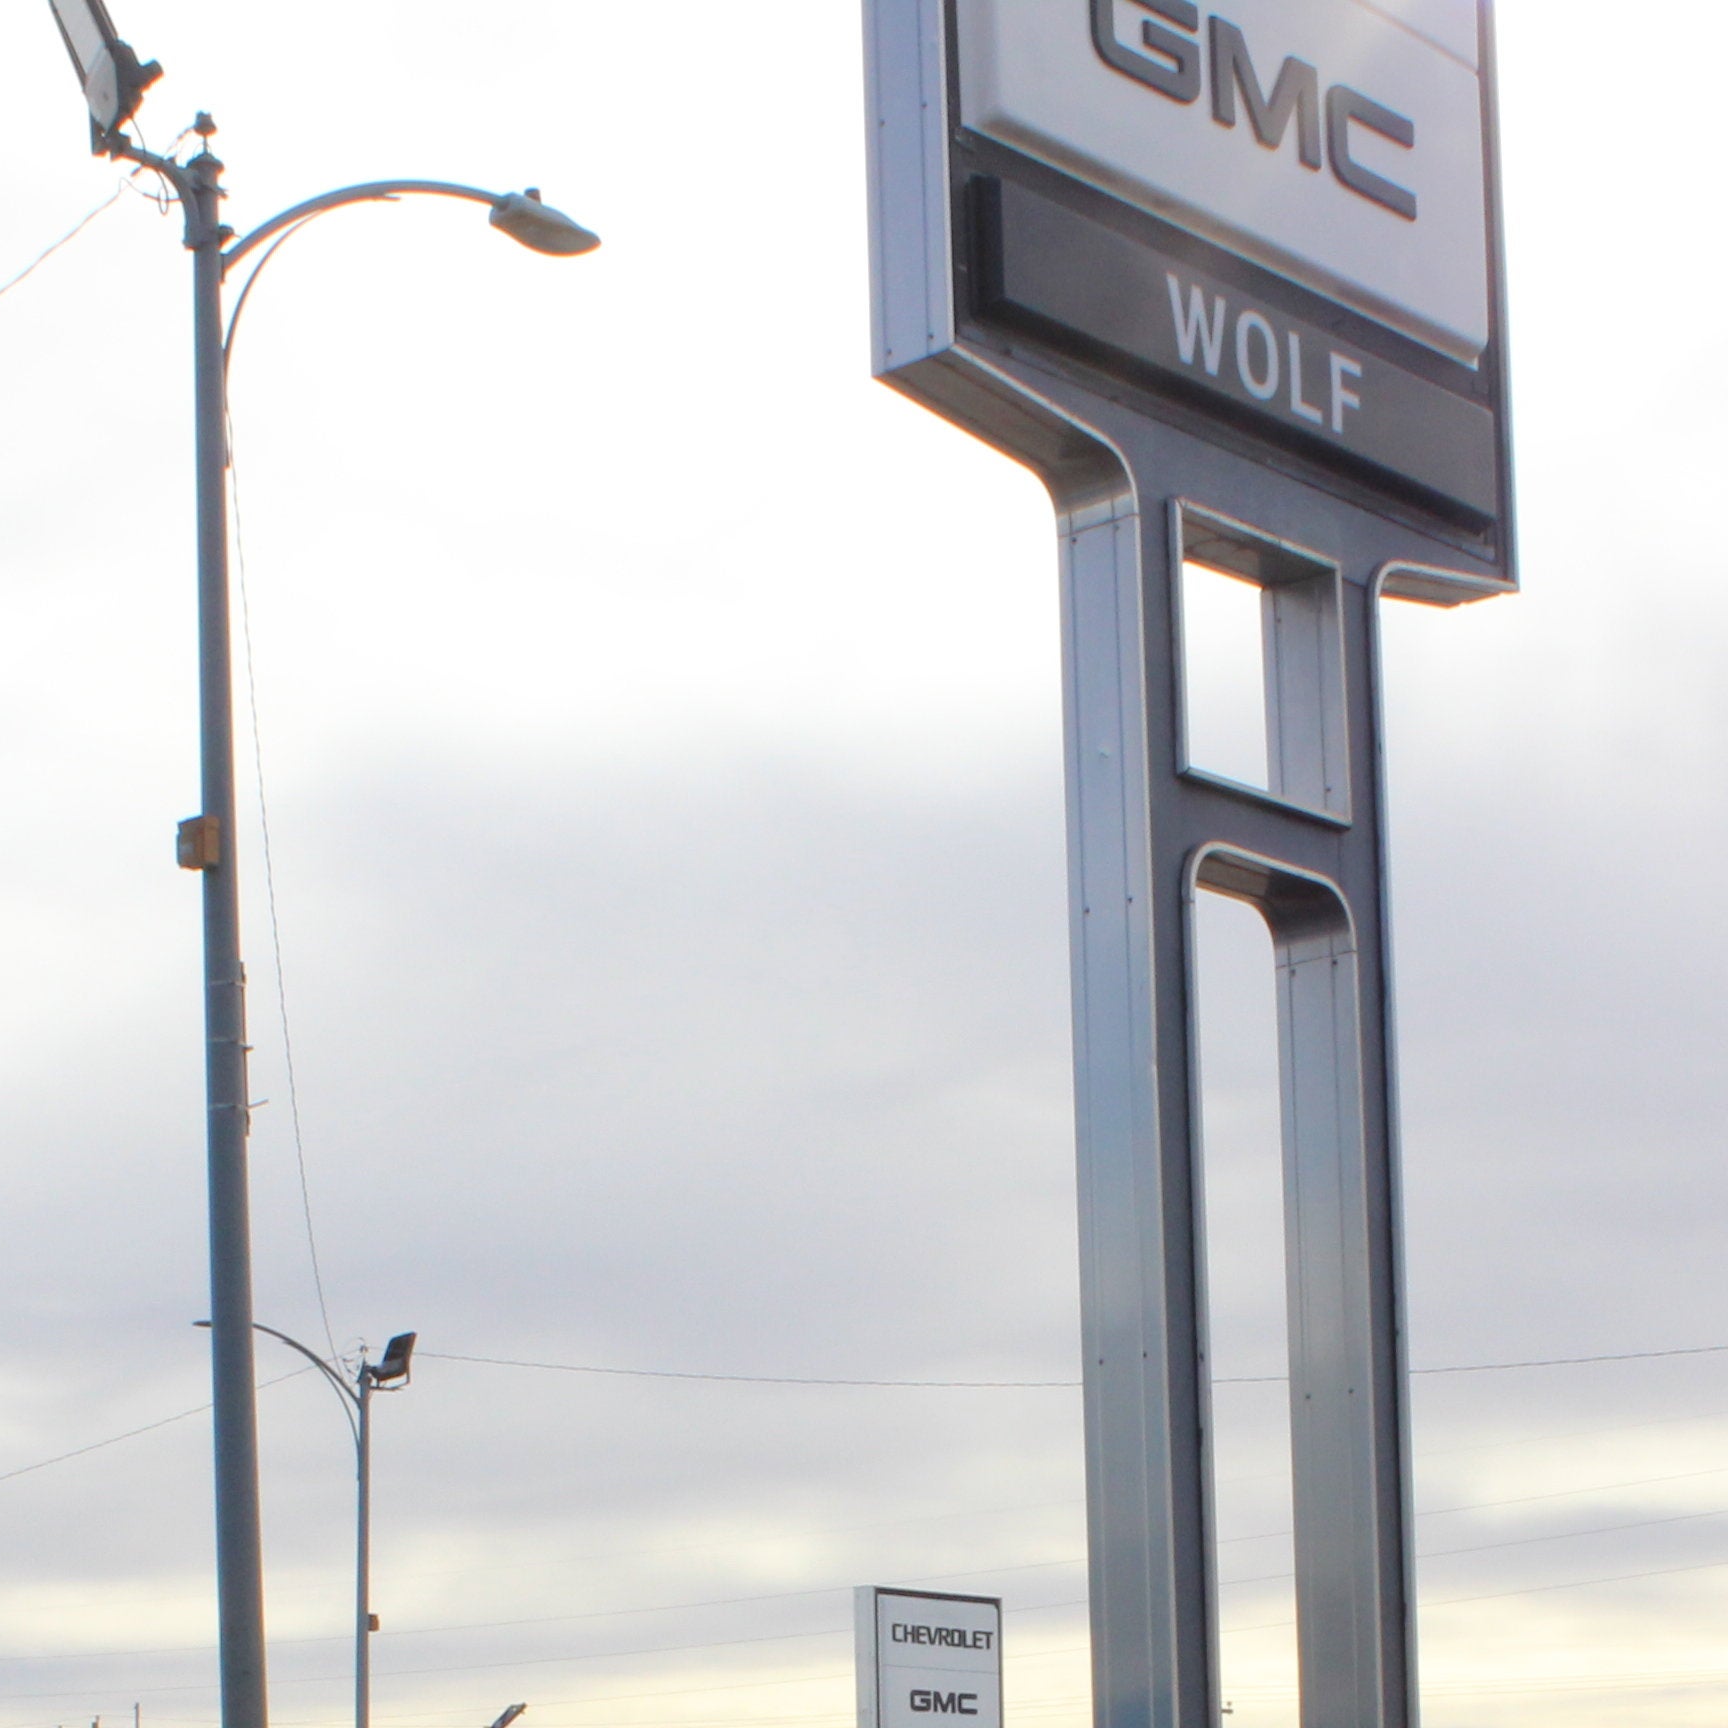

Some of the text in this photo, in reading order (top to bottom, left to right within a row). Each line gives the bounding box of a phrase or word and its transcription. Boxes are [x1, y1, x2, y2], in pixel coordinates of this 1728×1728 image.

[1089, 0, 1418, 222] GMC
[1166, 271, 1363, 435] WOLF
[891, 1622, 994, 1650] CHEVROLET
[909, 1689, 978, 1715] GMC
